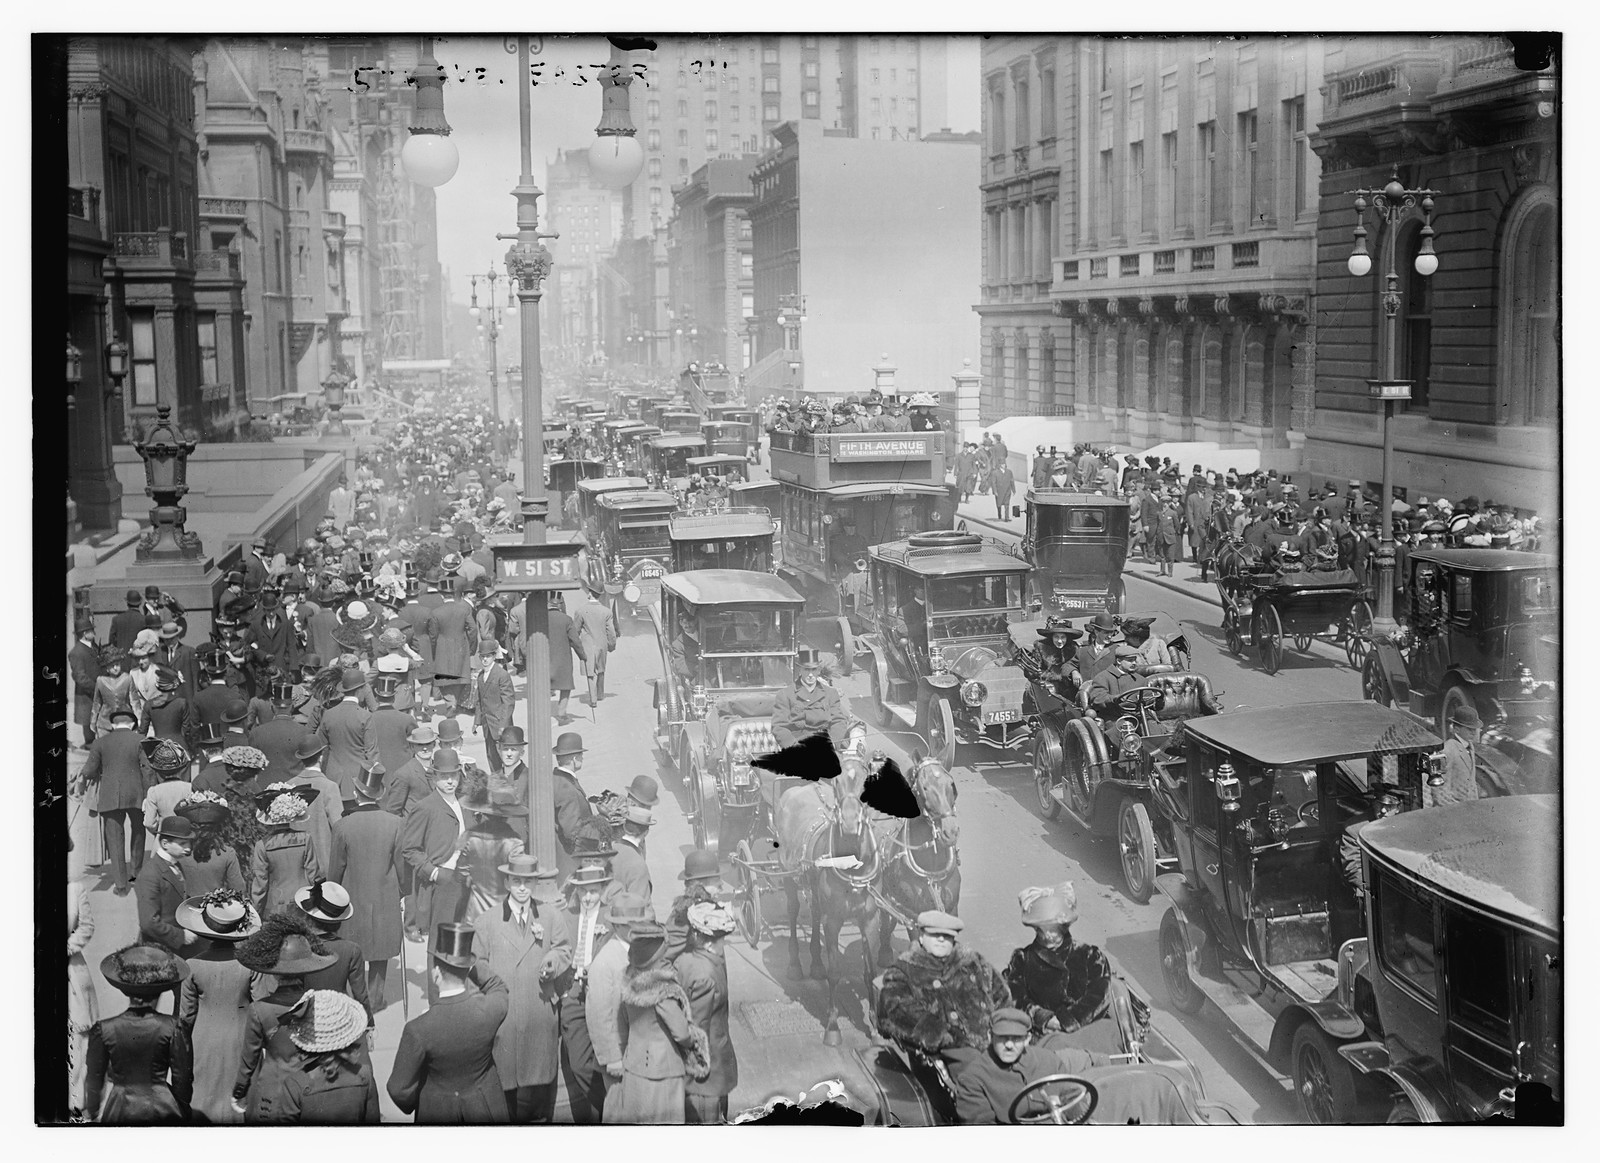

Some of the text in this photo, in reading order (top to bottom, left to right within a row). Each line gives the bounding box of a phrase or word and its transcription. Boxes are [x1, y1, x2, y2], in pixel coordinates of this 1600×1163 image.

[839, 441, 924, 450] FIFTH AVENUE
[504, 559, 571, 577] W. 51 ST.
[988, 710, 1011, 723] 7455
